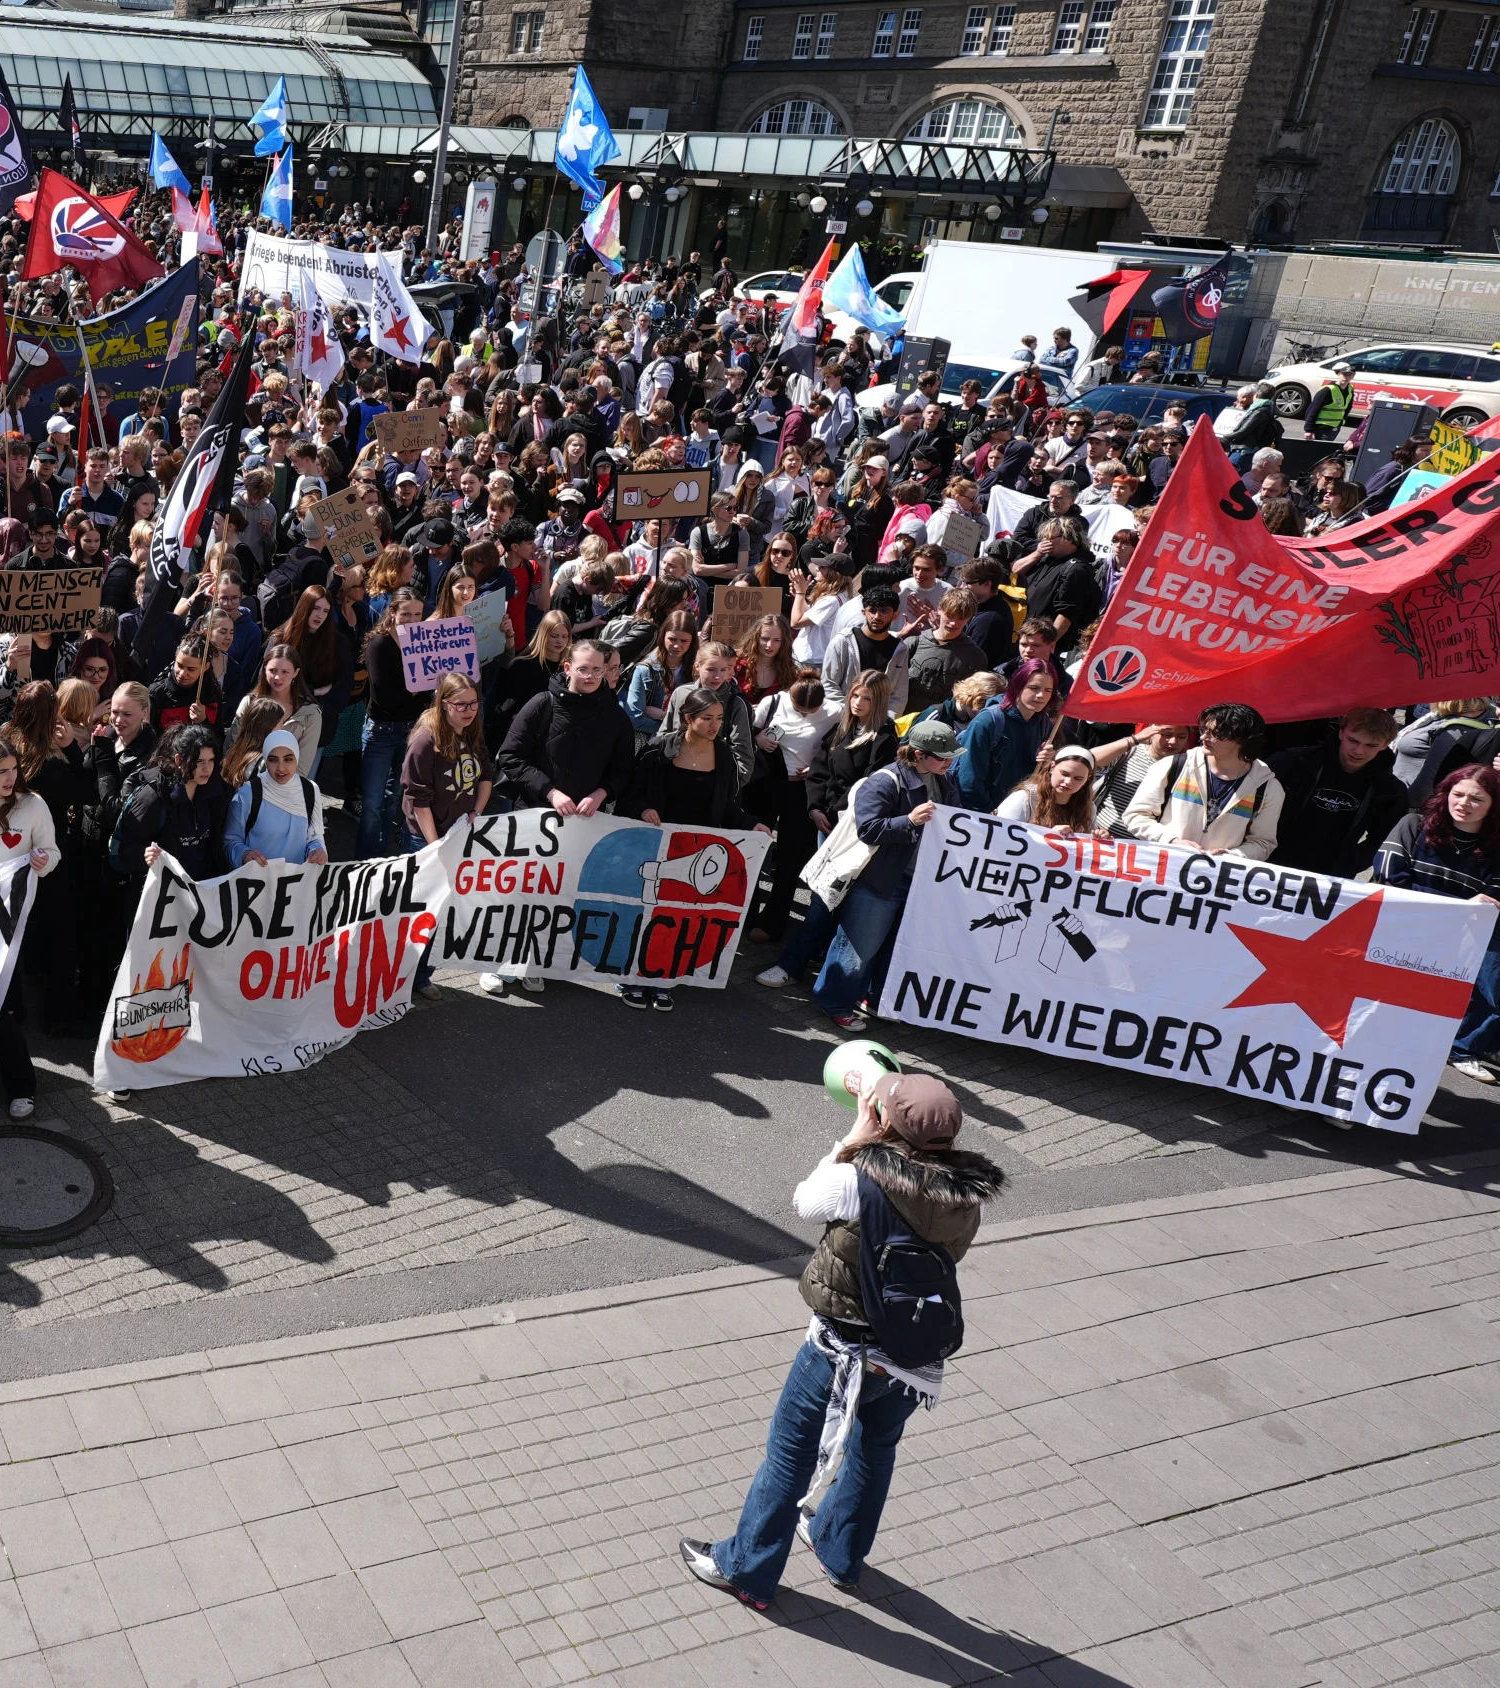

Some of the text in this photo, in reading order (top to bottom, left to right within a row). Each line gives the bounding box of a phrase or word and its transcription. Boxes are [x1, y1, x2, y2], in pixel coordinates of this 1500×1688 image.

[584, 201, 600, 209] TAX
[277, 249, 322, 271] beenden!
[325, 258, 378, 281] Abrüste
[402, 434, 438, 448] Ostfront
[333, 509, 363, 530] DUNG
[19, 570, 102, 591] MENSCH
[1153, 530, 1351, 609] FÜR EINE
[15, 591, 81, 611] CENT
[724, 590, 762, 611] OUR
[409, 625, 432, 642] Wir
[432, 623, 474, 639] sterben
[1117, 600, 1305, 654] ZUKUN
[402, 638, 471, 656] nicht für eure
[421, 655, 461, 676] Kriege
[1151, 667, 1211, 684] Schüle
[462, 812, 564, 859] KLS
[454, 860, 565, 896] GEGEN
[946, 812, 1343, 922] STS STELLI GEGEN
[149, 856, 427, 948] EURE KRIEGE
[444, 904, 740, 981] WEHRPFLICHT
[239, 911, 436, 1029] OHNE UNS
[894, 971, 1417, 1121] NIE WIEDER KRIEG
[241, 1055, 283, 1078] KLS
